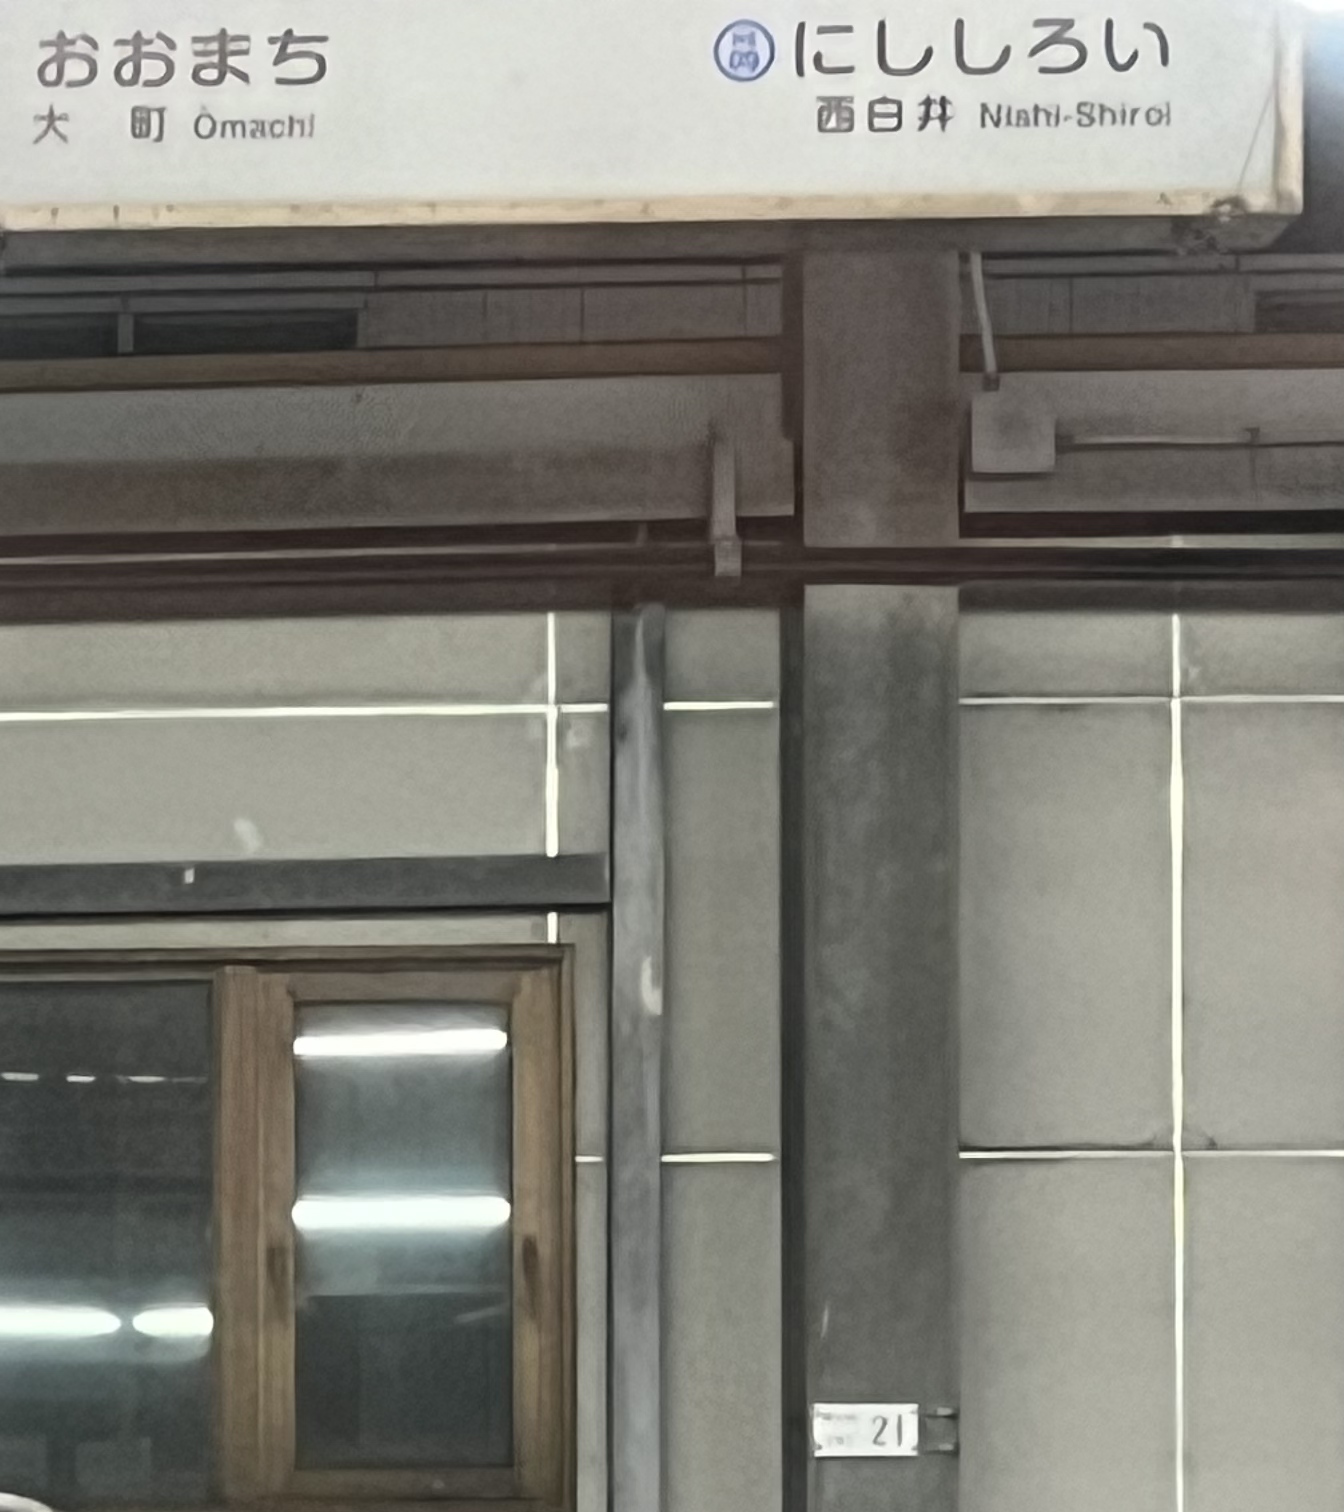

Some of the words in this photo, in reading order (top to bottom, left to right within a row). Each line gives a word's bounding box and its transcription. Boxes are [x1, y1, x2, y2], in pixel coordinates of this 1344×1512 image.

[37, 27, 329, 88] おおまち
[795, 17, 1169, 77] にししろい
[816, 94, 954, 133] 西白井
[980, 101, 1171, 128] Nishi-Shiroi
[872, 1415, 902, 1447] 21
